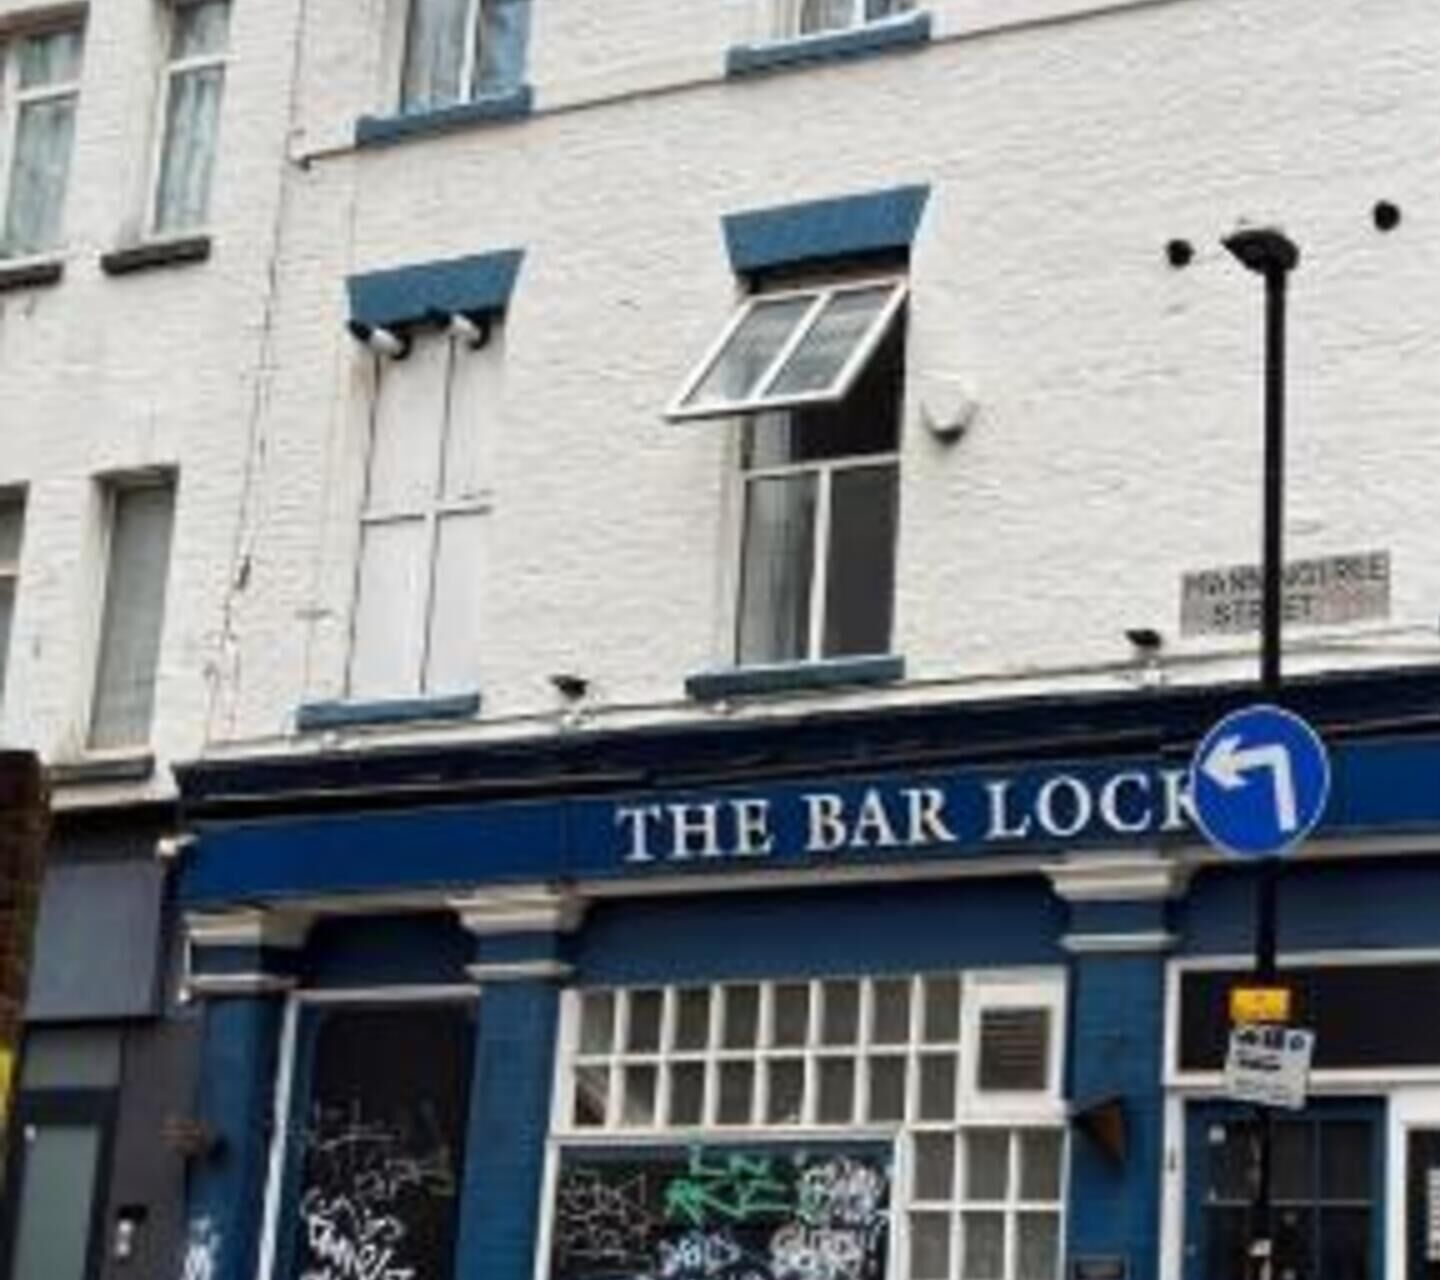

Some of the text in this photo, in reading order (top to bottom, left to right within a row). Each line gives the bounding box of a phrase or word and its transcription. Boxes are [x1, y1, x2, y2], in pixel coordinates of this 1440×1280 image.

[1213, 593, 1317, 626] STRET
[614, 770, 1195, 862] THE BAR LOCK
